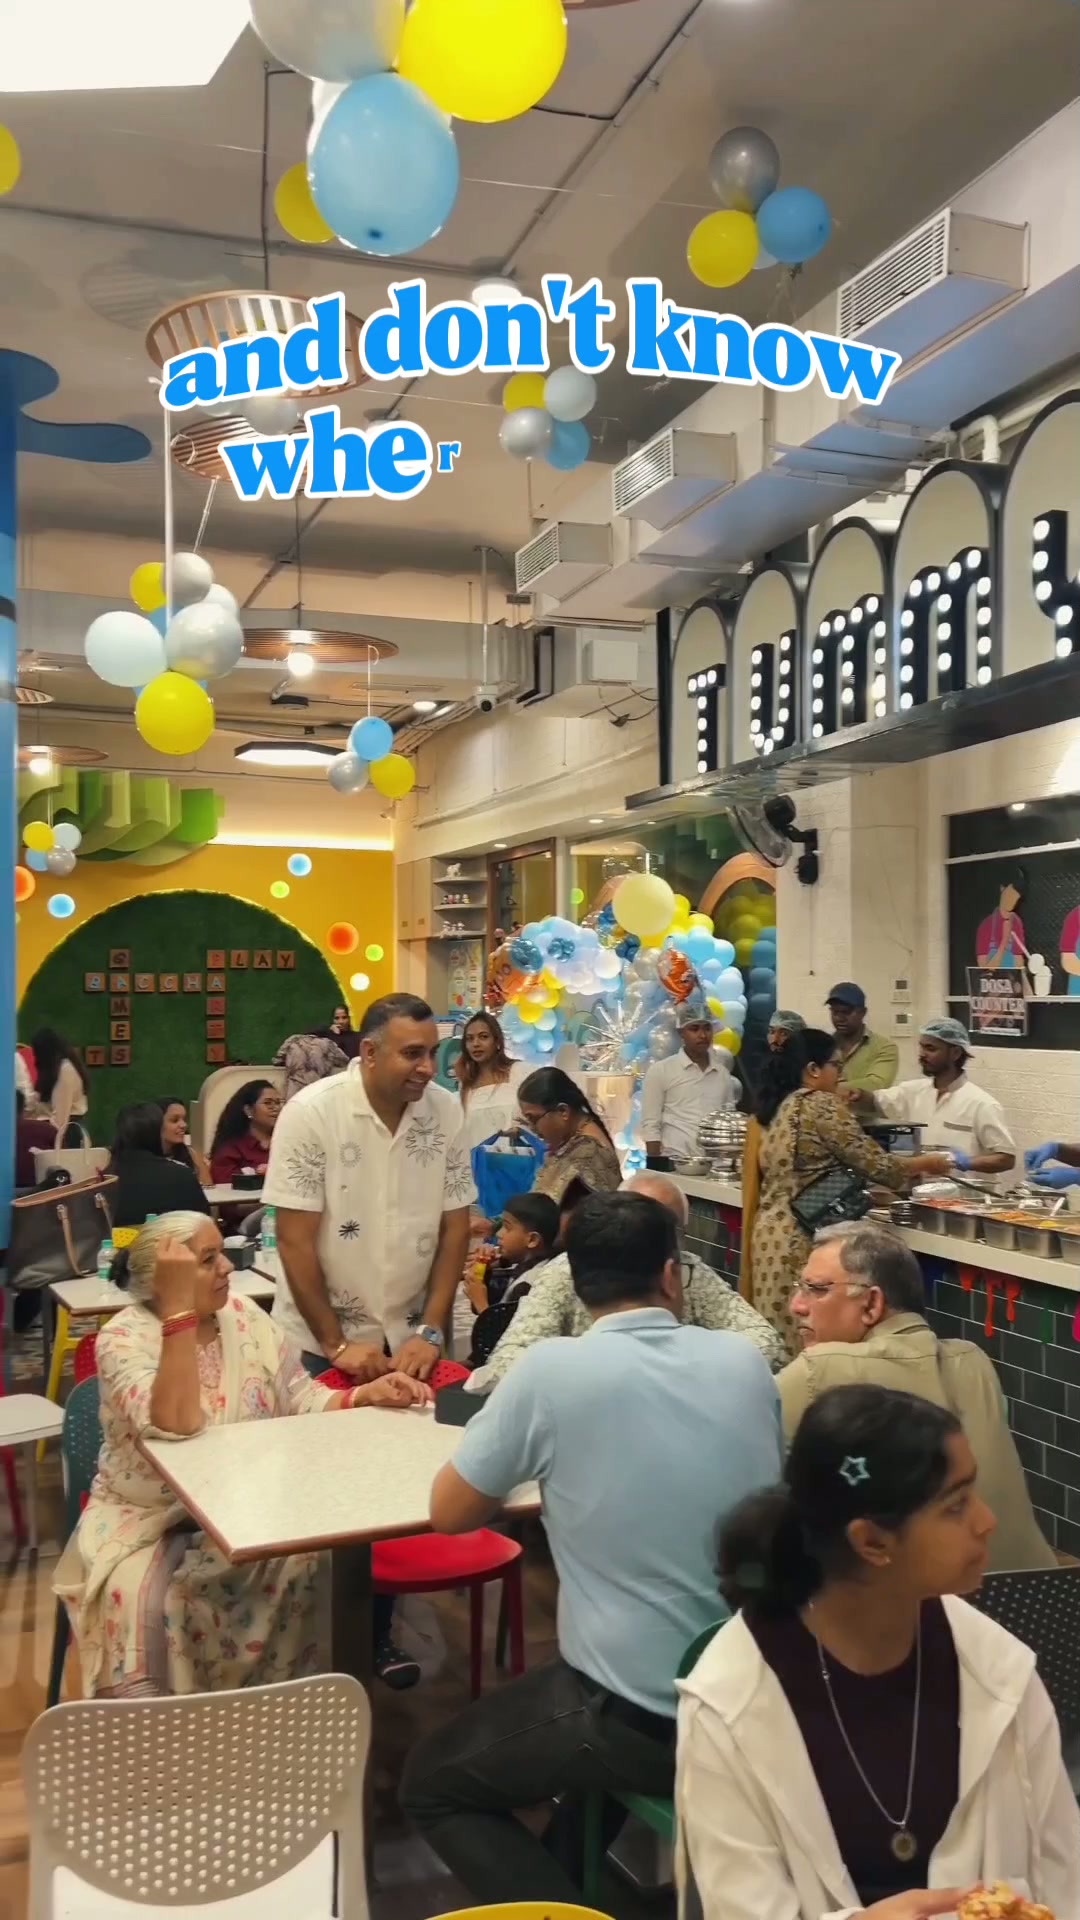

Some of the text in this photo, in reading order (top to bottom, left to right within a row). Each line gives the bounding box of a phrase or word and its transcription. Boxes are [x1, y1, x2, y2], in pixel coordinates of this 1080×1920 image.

[209, 950, 294, 969] PLAY
[87, 974, 224, 991] BACCHA
[980, 978, 1013, 993] DOSA
[112, 950, 129, 1064] GAMES
[971, 996, 1025, 1012] COUNTER
